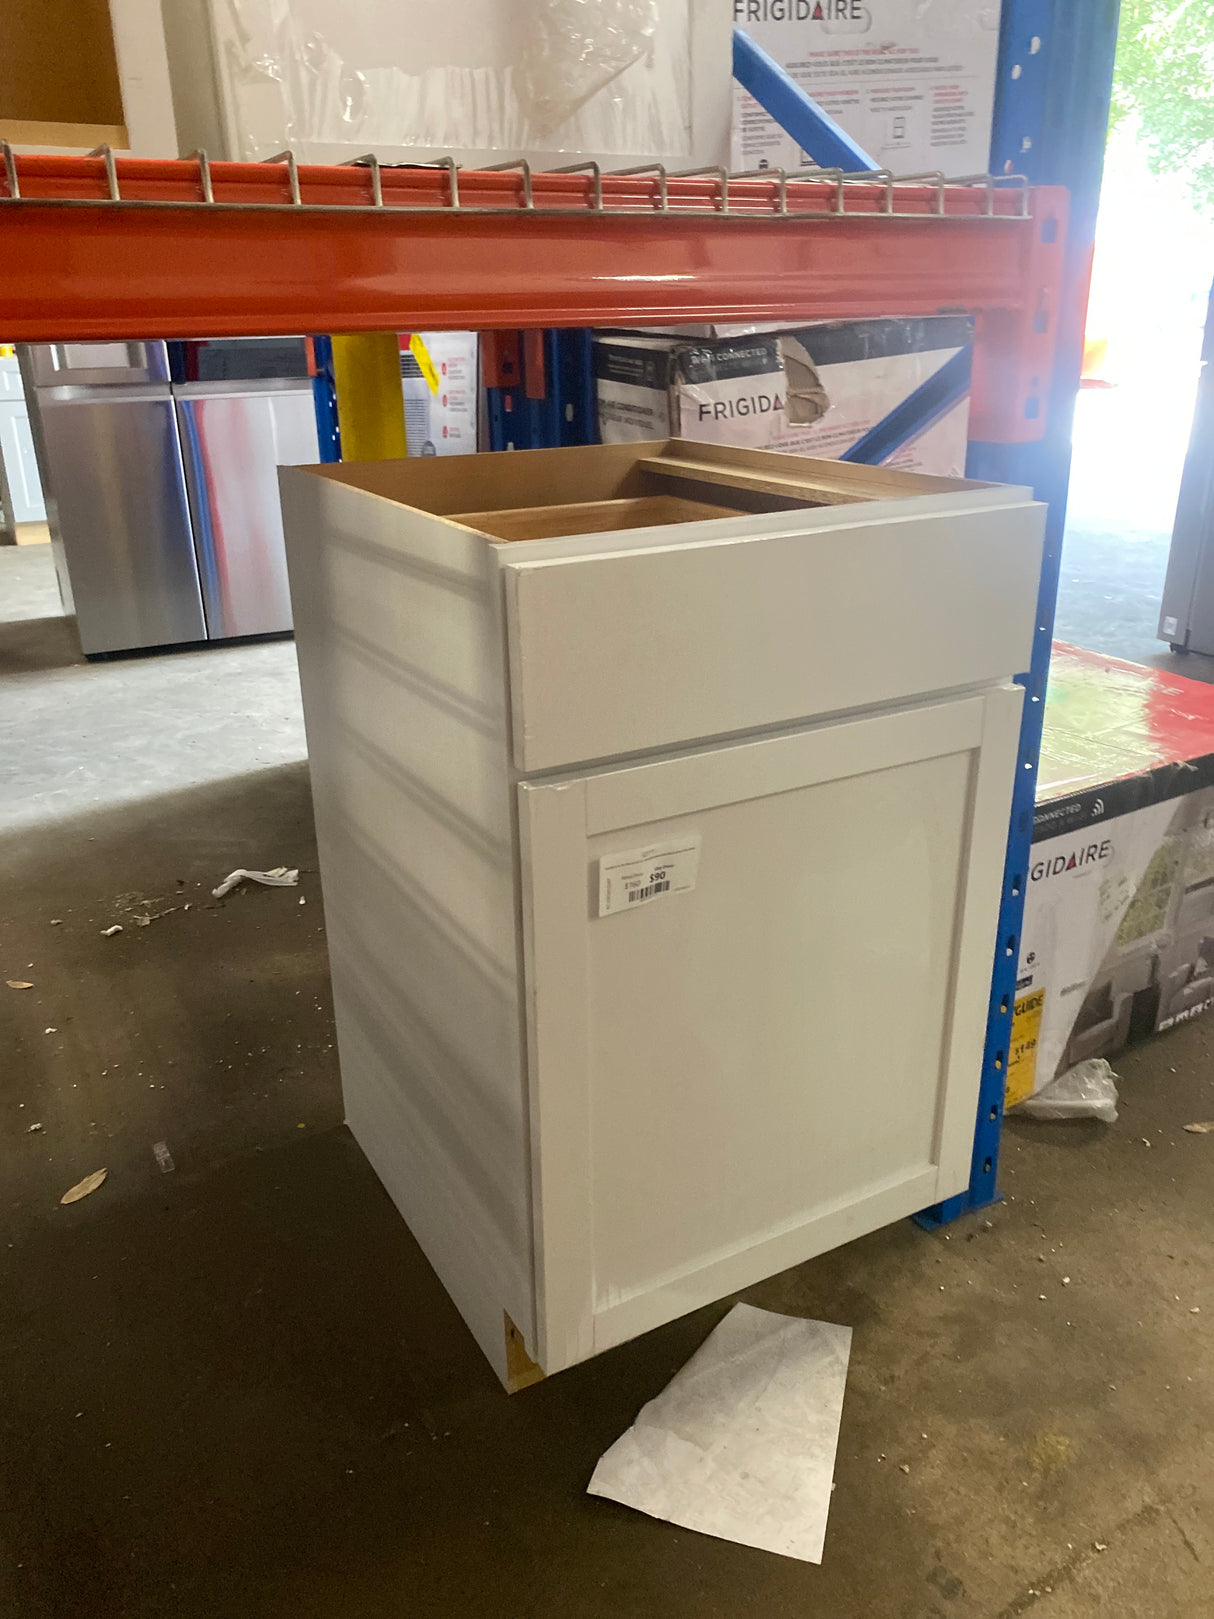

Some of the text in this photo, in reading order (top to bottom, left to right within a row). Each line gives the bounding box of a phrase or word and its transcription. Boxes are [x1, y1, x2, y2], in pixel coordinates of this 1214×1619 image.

[734, 0, 862, 21] FRIGIDAIRE
[699, 393, 784, 421] FRIGIDA
[1033, 803, 1081, 824] ONNECTED
[1031, 840, 1111, 881] GIDAIRE
[650, 871, 666, 883] $90
[1014, 994, 1044, 1017] GUIDE
